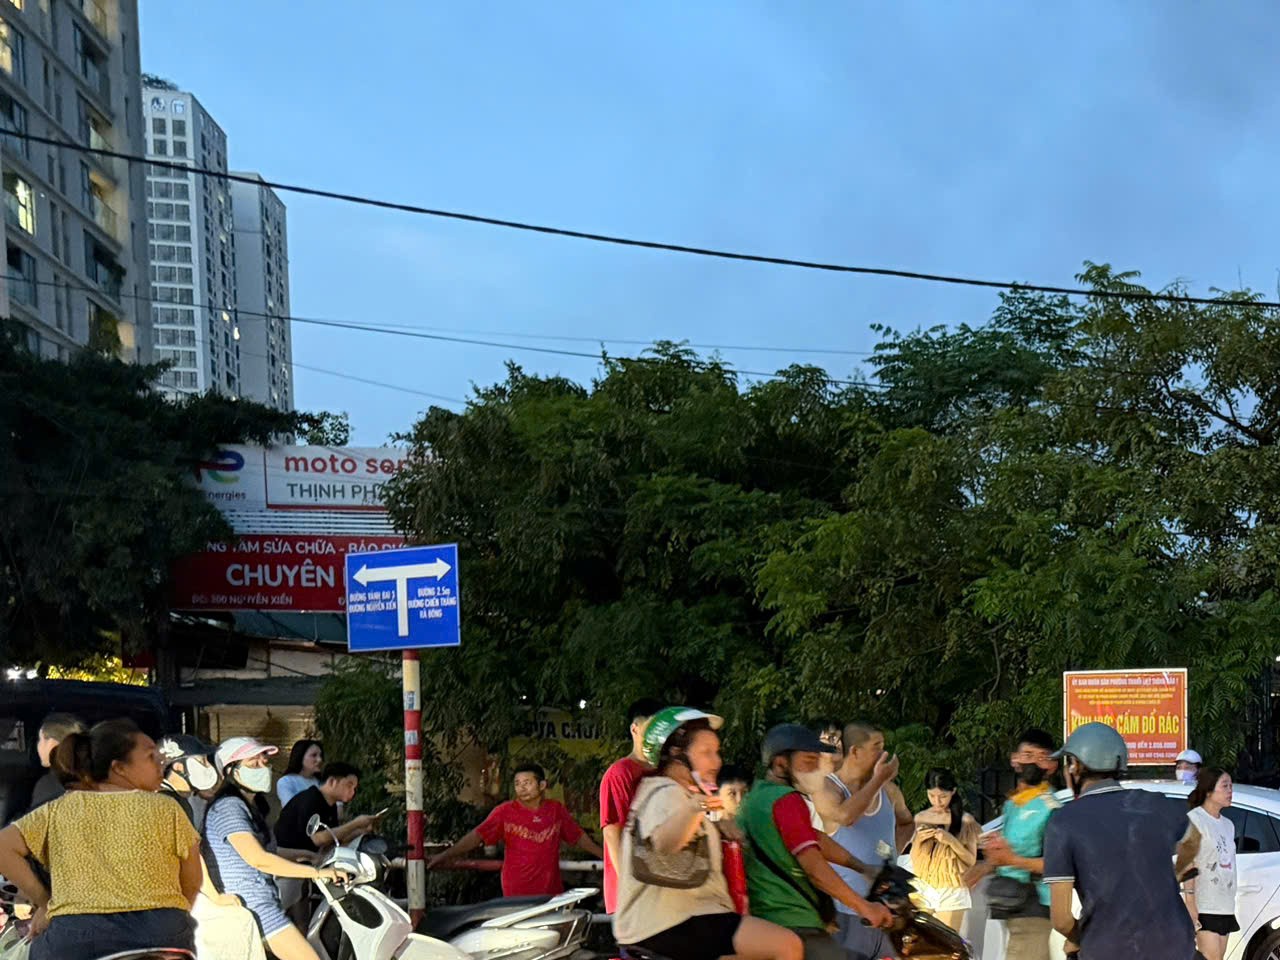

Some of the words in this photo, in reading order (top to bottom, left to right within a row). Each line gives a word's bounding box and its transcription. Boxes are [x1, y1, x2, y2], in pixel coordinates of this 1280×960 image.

[284, 453, 358, 475] moto
[286, 483, 345, 502] THỊNH
[263, 538, 292, 554] SỬA
[295, 539, 336, 555] CHỮA
[225, 558, 336, 588] CHUYÊN
[1116, 708, 1140, 735] CẤM
[1141, 707, 1156, 735] ĐỔ
[1158, 711, 1180, 735] RÁC
